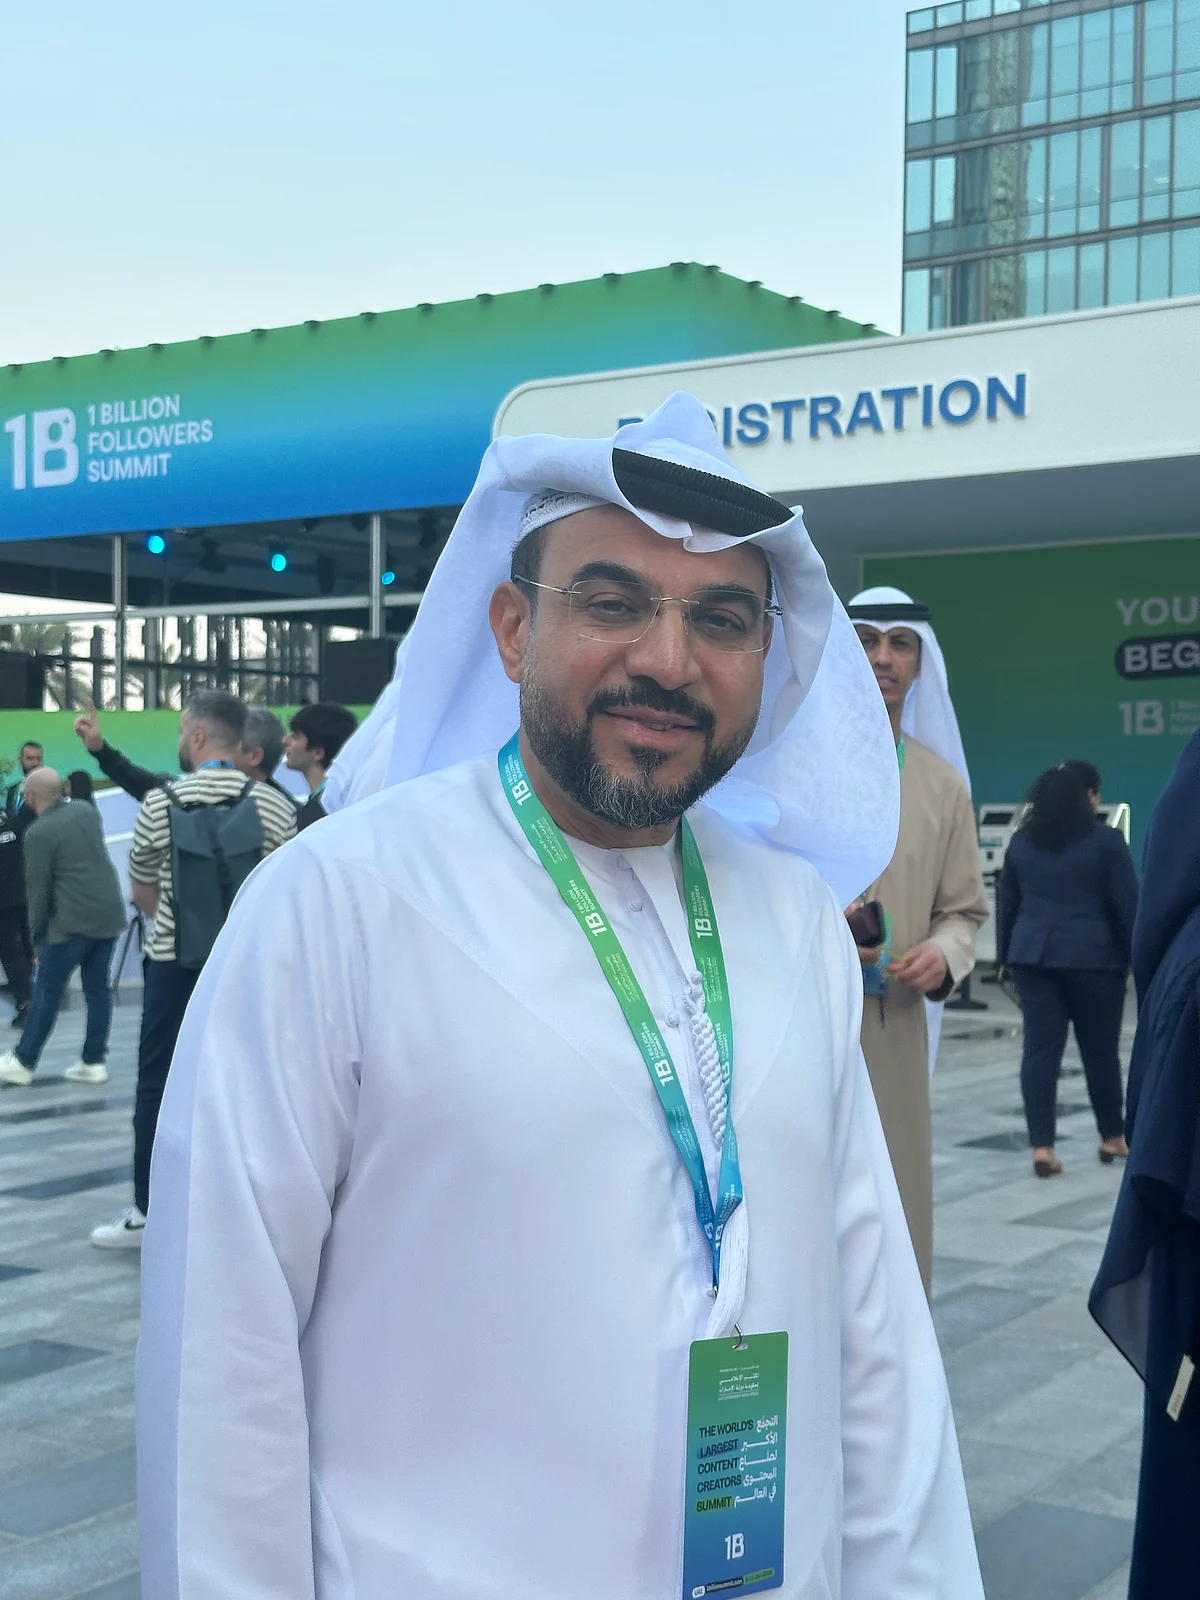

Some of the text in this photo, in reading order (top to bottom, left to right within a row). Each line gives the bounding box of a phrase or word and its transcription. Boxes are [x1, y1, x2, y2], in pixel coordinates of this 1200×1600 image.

[88, 394, 180, 426] 1 BILLION
[618, 373, 1026, 447] ISTRATION
[4, 408, 79, 490] 1B
[88, 420, 213, 454] FOLLOWERS
[88, 453, 172, 483] SUMMIT
[1118, 700, 1164, 735] 1B
[511, 779, 532, 806] 1B
[584, 911, 607, 936] 1B
[694, 918, 712, 938] 1B
[653, 1058, 674, 1087] 1B
[699, 1419, 754, 1438] THE WORLD'S
[700, 1439, 739, 1458] LARGEST
[698, 1457, 740, 1474] CONTENT
[697, 1475, 742, 1493] CREATORS
[696, 1496, 732, 1512] SUMMIT
[724, 1532, 745, 1560] 1B
